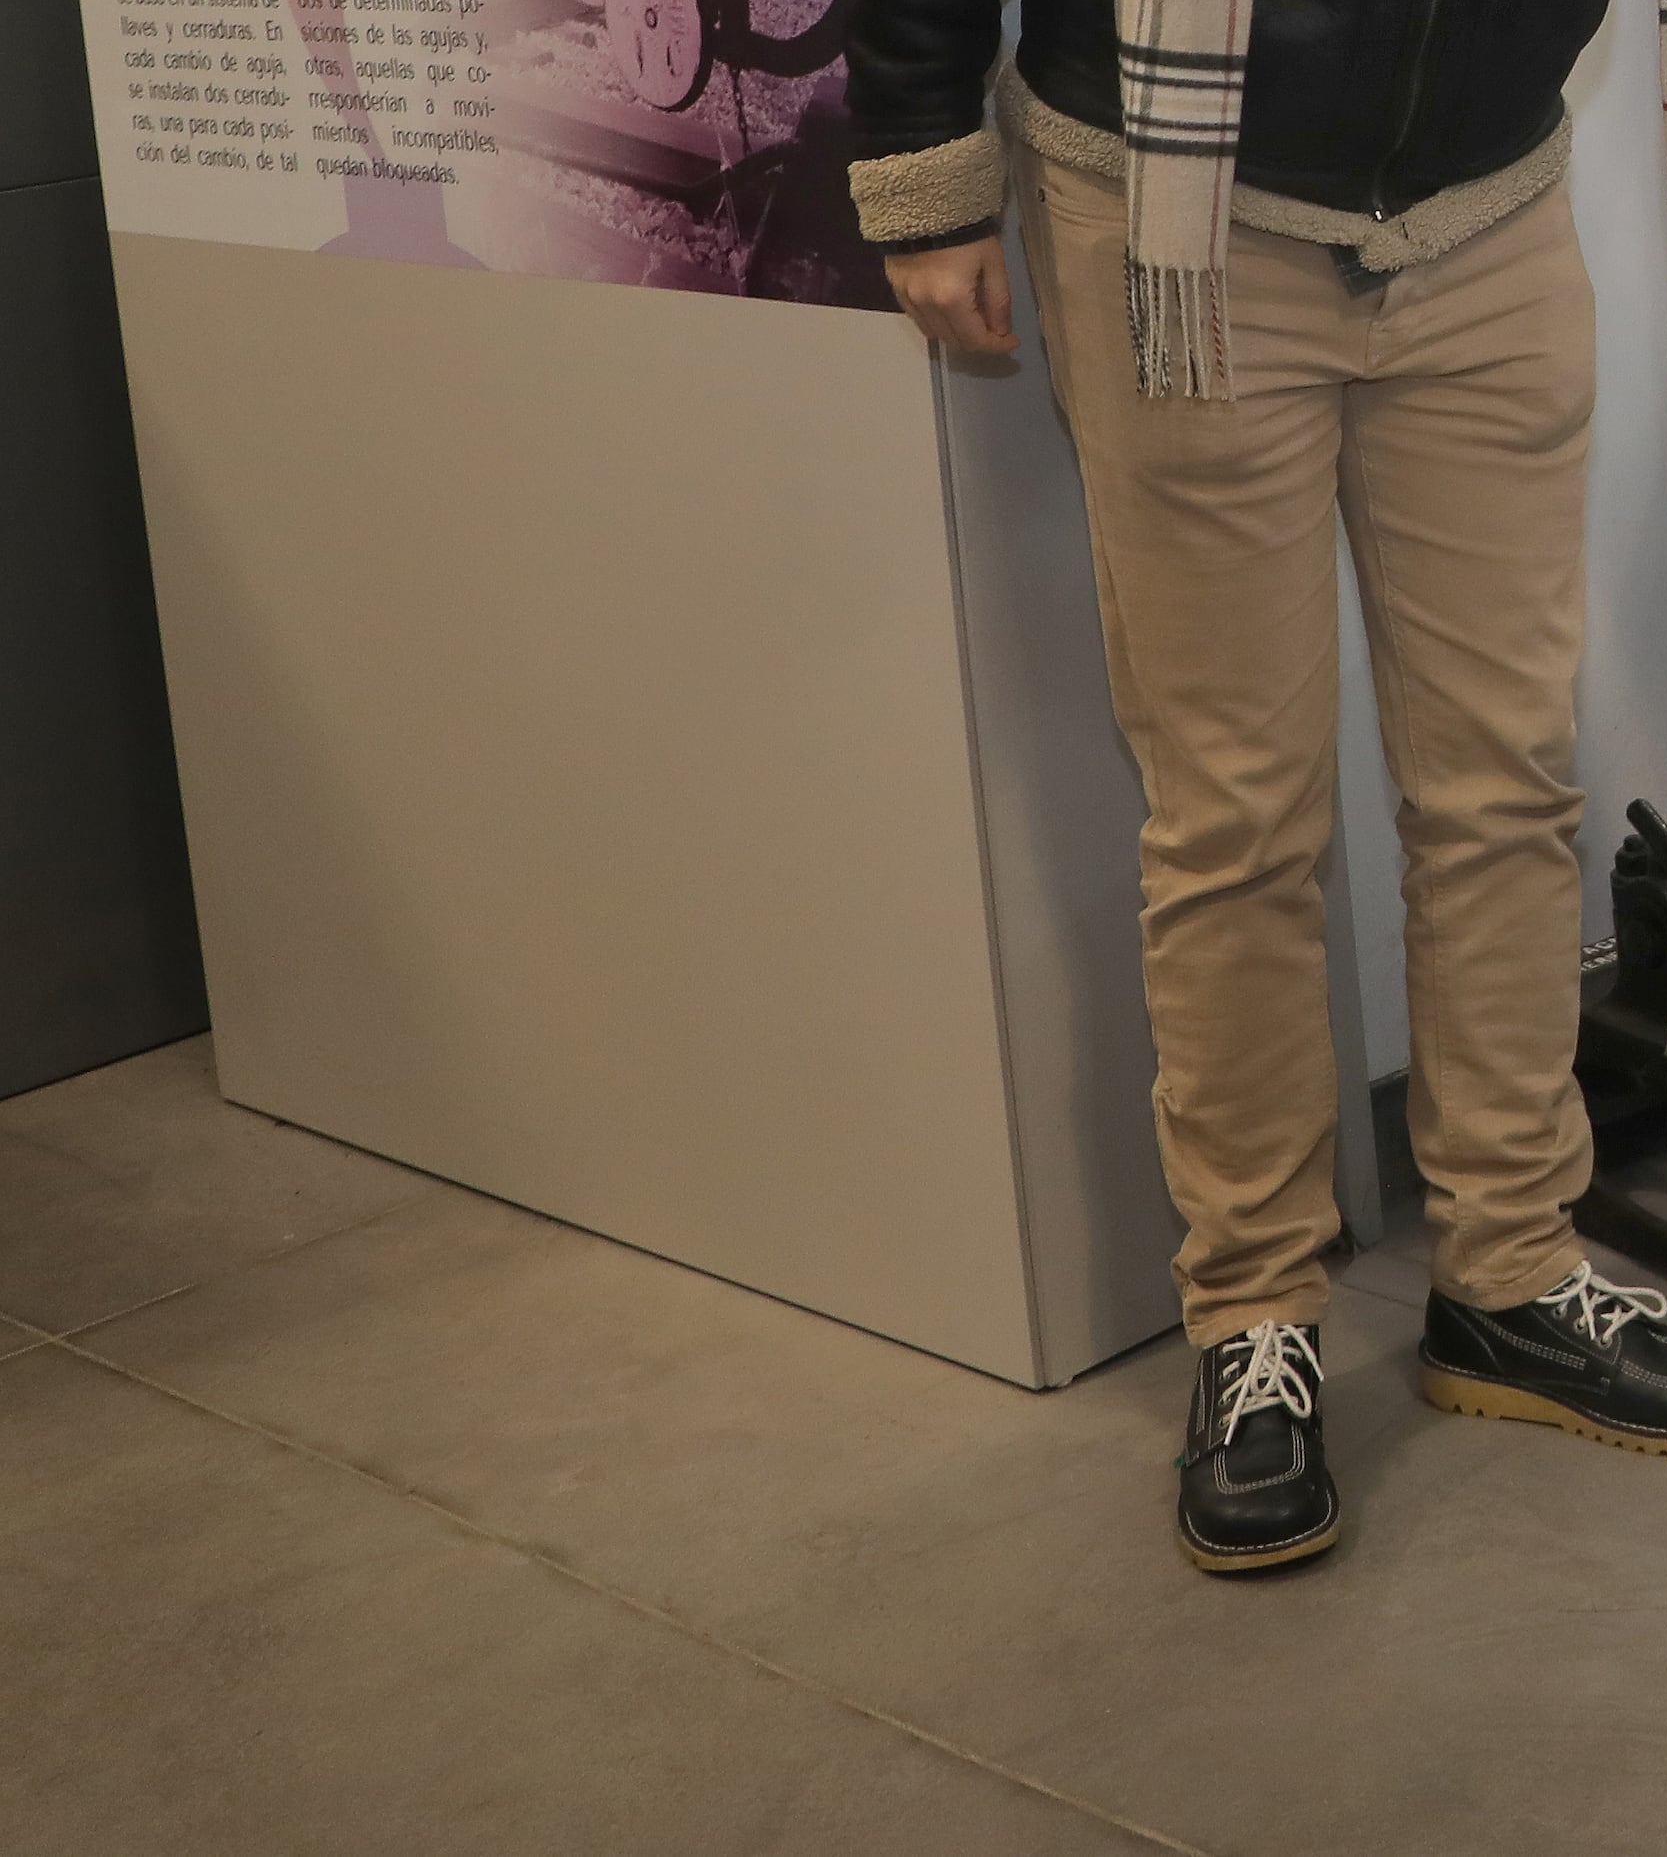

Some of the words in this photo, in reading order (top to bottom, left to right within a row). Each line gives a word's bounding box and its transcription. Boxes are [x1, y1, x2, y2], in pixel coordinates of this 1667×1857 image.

[301, 22, 358, 44] siciones
[366, 24, 384, 45] de
[392, 24, 413, 46] las
[420, 26, 468, 54] agujas
[475, 31, 488, 55] y,
[305, 58, 344, 78] otras,
[356, 58, 415, 84] aquellas
[427, 64, 455, 87] que
[468, 65, 491, 84] co-
[309, 91, 407, 114] rresponderían
[426, 97, 434, 114] a
[453, 96, 495, 117] movi-
[313, 122, 369, 144] mientos
[392, 126, 499, 155] incompatibles,
[317, 156, 368, 180] quedan
[372, 158, 459, 186] bloqueadas.
